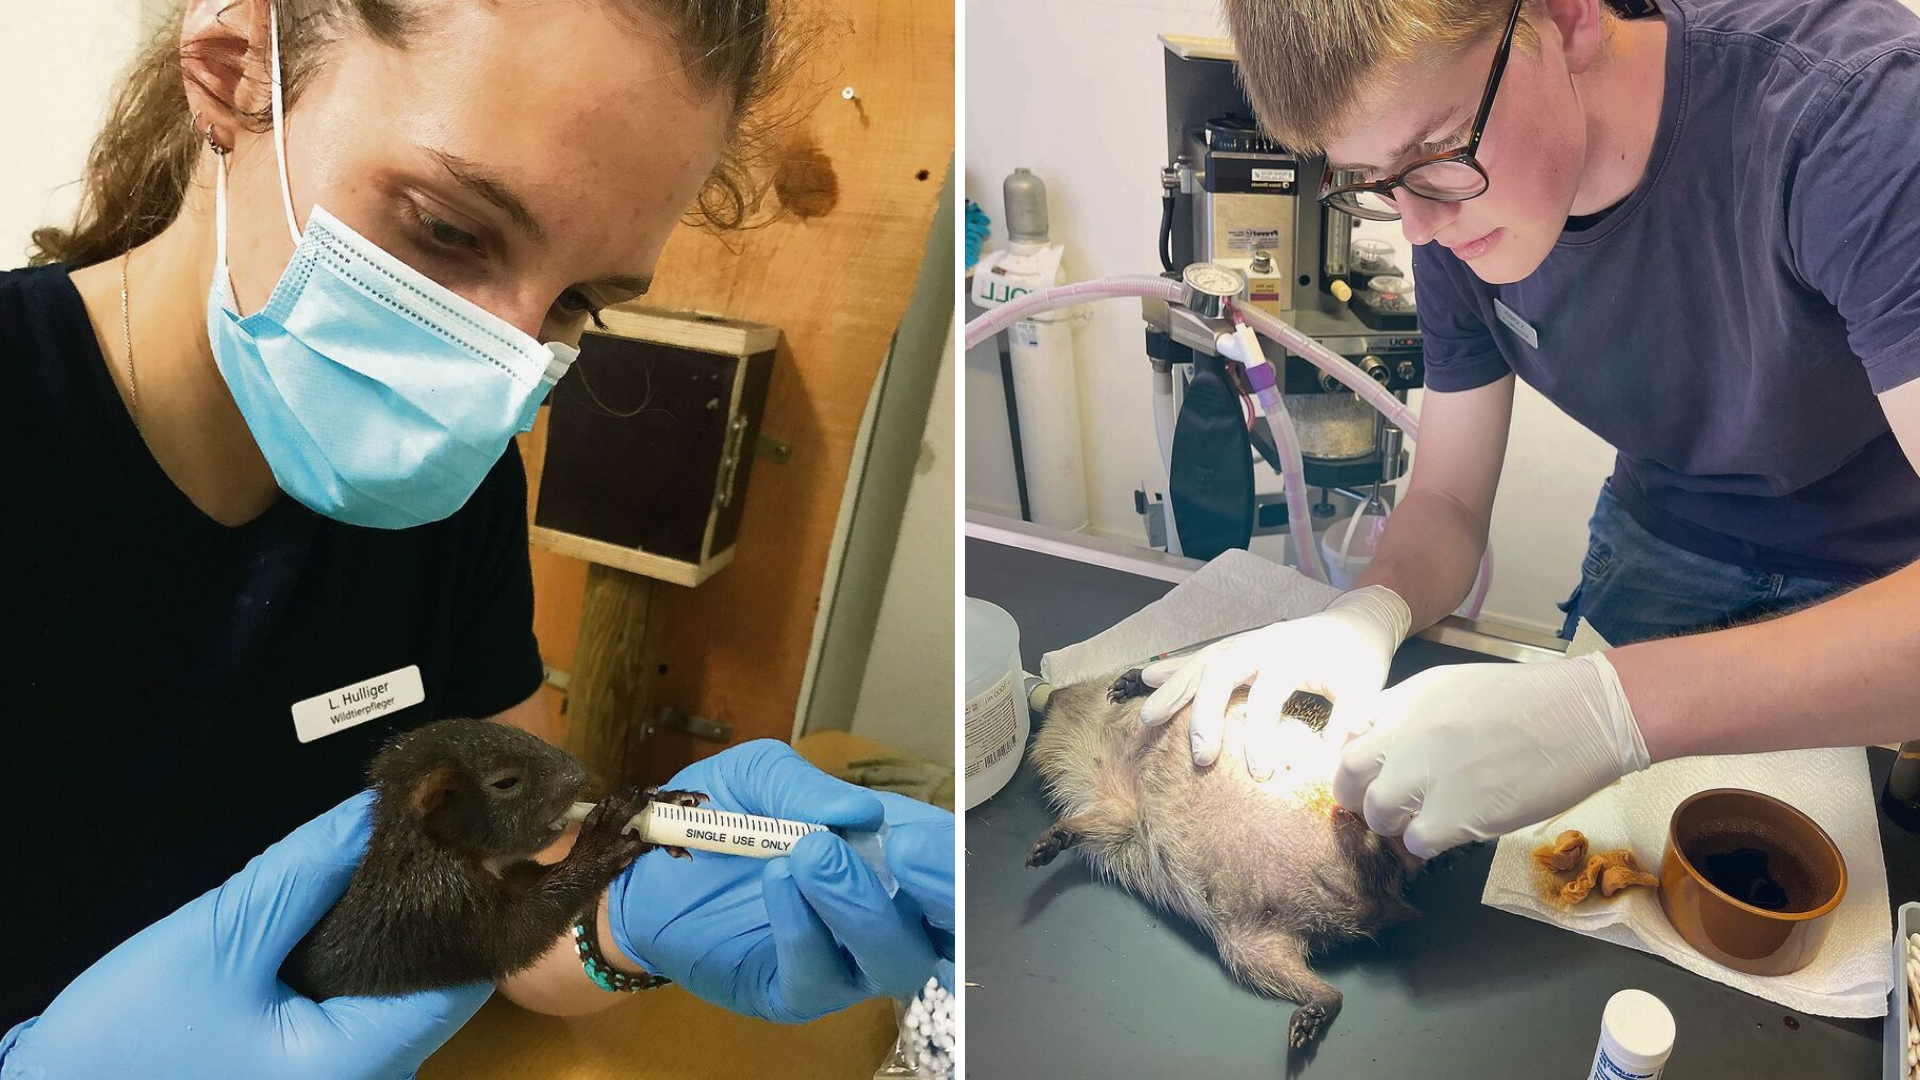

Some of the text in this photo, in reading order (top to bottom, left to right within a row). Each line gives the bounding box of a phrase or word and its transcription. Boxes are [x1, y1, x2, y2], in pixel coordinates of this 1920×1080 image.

[328, 682, 389, 710] L. Hulliger
[330, 696, 395, 725] Wildtierpfleger
[686, 828, 791, 851] SINGLE USE ONLY
